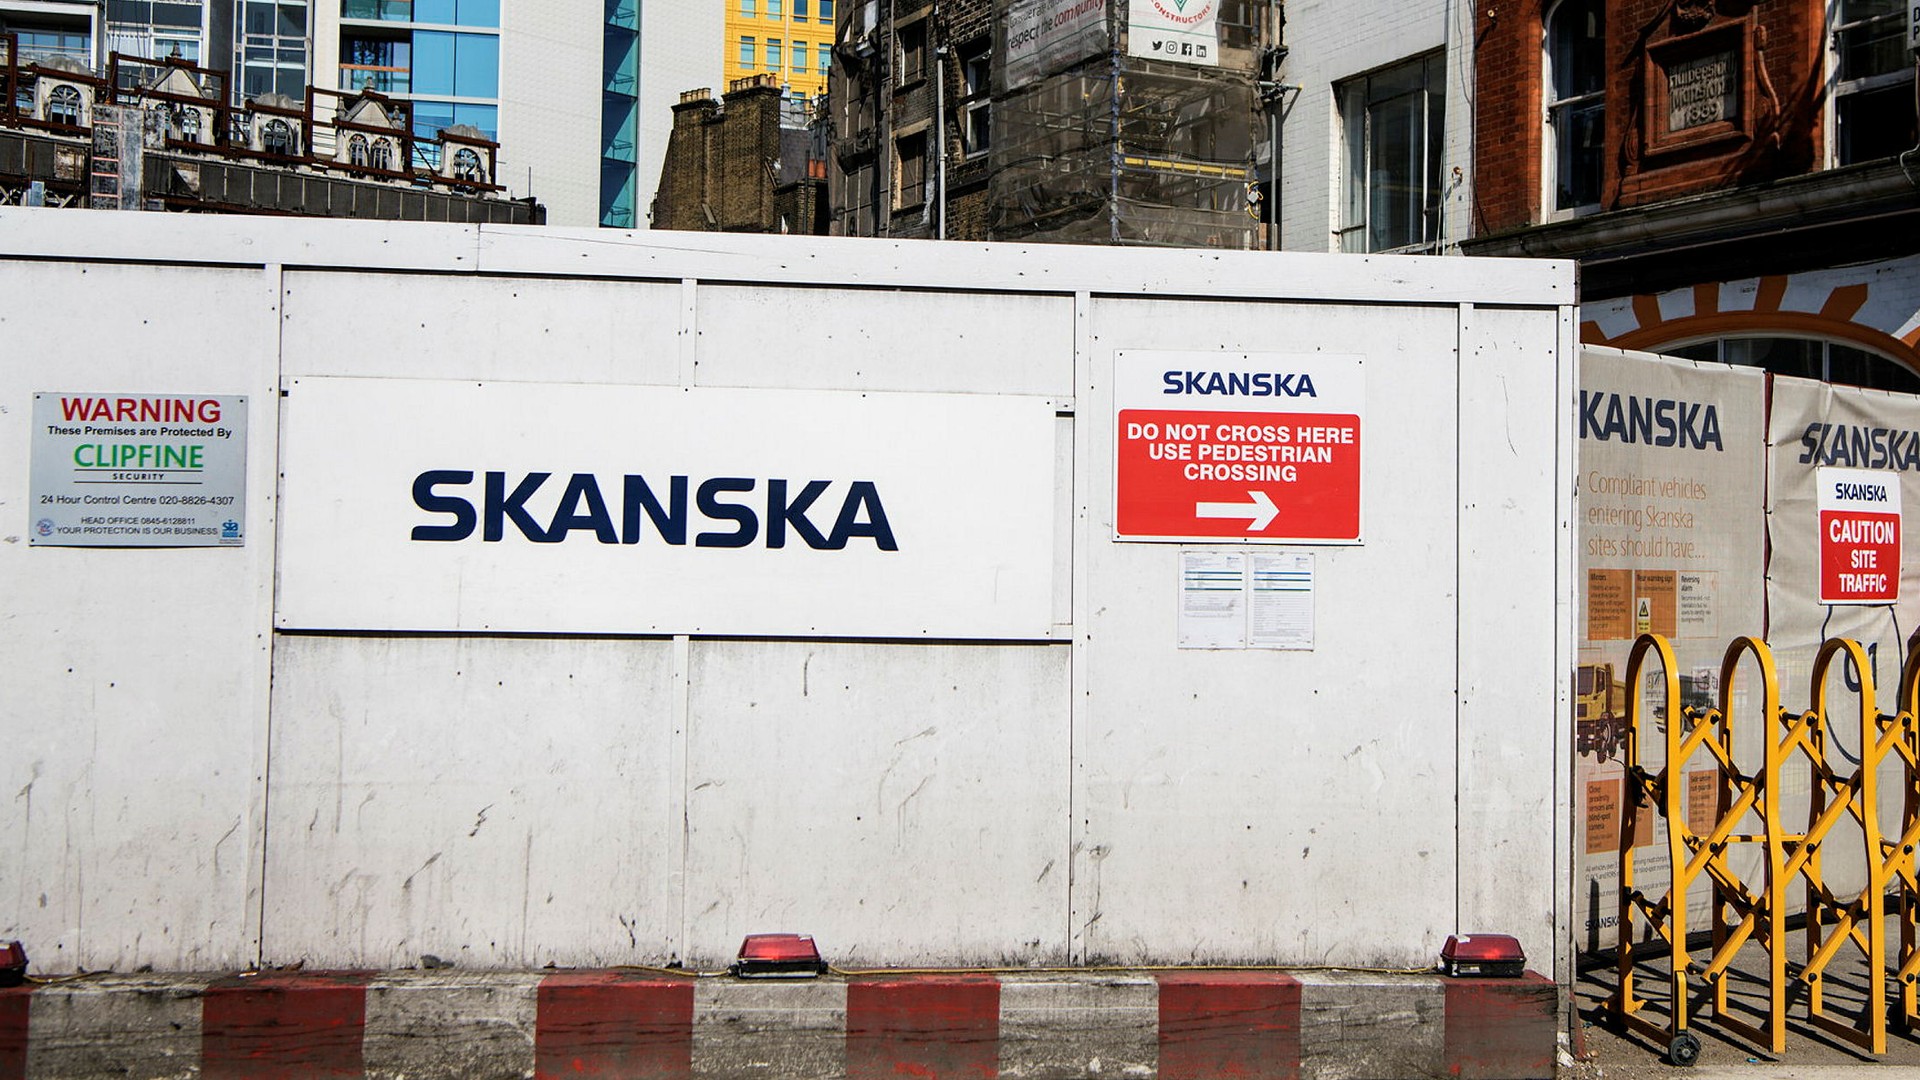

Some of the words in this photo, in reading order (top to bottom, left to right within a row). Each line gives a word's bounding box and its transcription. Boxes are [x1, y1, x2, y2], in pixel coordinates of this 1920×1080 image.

[1008, 24, 1039, 50] respect
[1042, 16, 1053, 34] the
[1054, 0, 1104, 28] community
[1163, 371, 1317, 398] SKANSKA
[61, 398, 221, 424] WARNING
[1580, 390, 1724, 452] KANSKA
[48, 426, 81, 436] These
[84, 426, 137, 436] Premises
[140, 428, 157, 436] are
[160, 427, 214, 437] Protected
[217, 428, 232, 439] By
[1128, 423, 1159, 440] DO
[1166, 424, 1210, 442] NOT
[1216, 426, 1290, 443] CROSS
[1298, 427, 1354, 444] HERE
[74, 444, 204, 468] CLIPFINE
[1150, 444, 1192, 460] USE
[1198, 444, 1332, 463] PEDESTRIAN
[1799, 422, 1920, 471] SKANSKA
[112, 472, 164, 480] SECURITY
[1184, 464, 1297, 482] CROSSING
[1588, 470, 1658, 500] Compliant
[1660, 475, 1707, 500] vehicles
[1836, 482, 1888, 502] SKANSKA
[41, 495, 54, 504] 24
[57, 495, 81, 504] Hour
[84, 495, 120, 505] Control
[124, 495, 157, 505] Centre
[159, 496, 234, 506] 020-8826-4307
[411, 470, 899, 552] SKANSKA
[81, 517, 106, 525] HEAD
[107, 517, 139, 525] OFFICE
[1588, 506, 1642, 530] entering
[1646, 506, 1694, 529] Skanska
[56, 526, 82, 535] YOUR
[84, 526, 140, 535] PROTECTION
[142, 526, 151, 535] IS
[152, 527, 172, 535] OUR
[174, 527, 218, 536] BUSINESS
[1829, 520, 1895, 545] CAUTION
[1588, 535, 1617, 557] sites
[1620, 536, 1663, 558] should
[1666, 538, 1706, 560] have...
[1850, 550, 1878, 569] SITE
[1839, 574, 1888, 594] TRAFFIC
